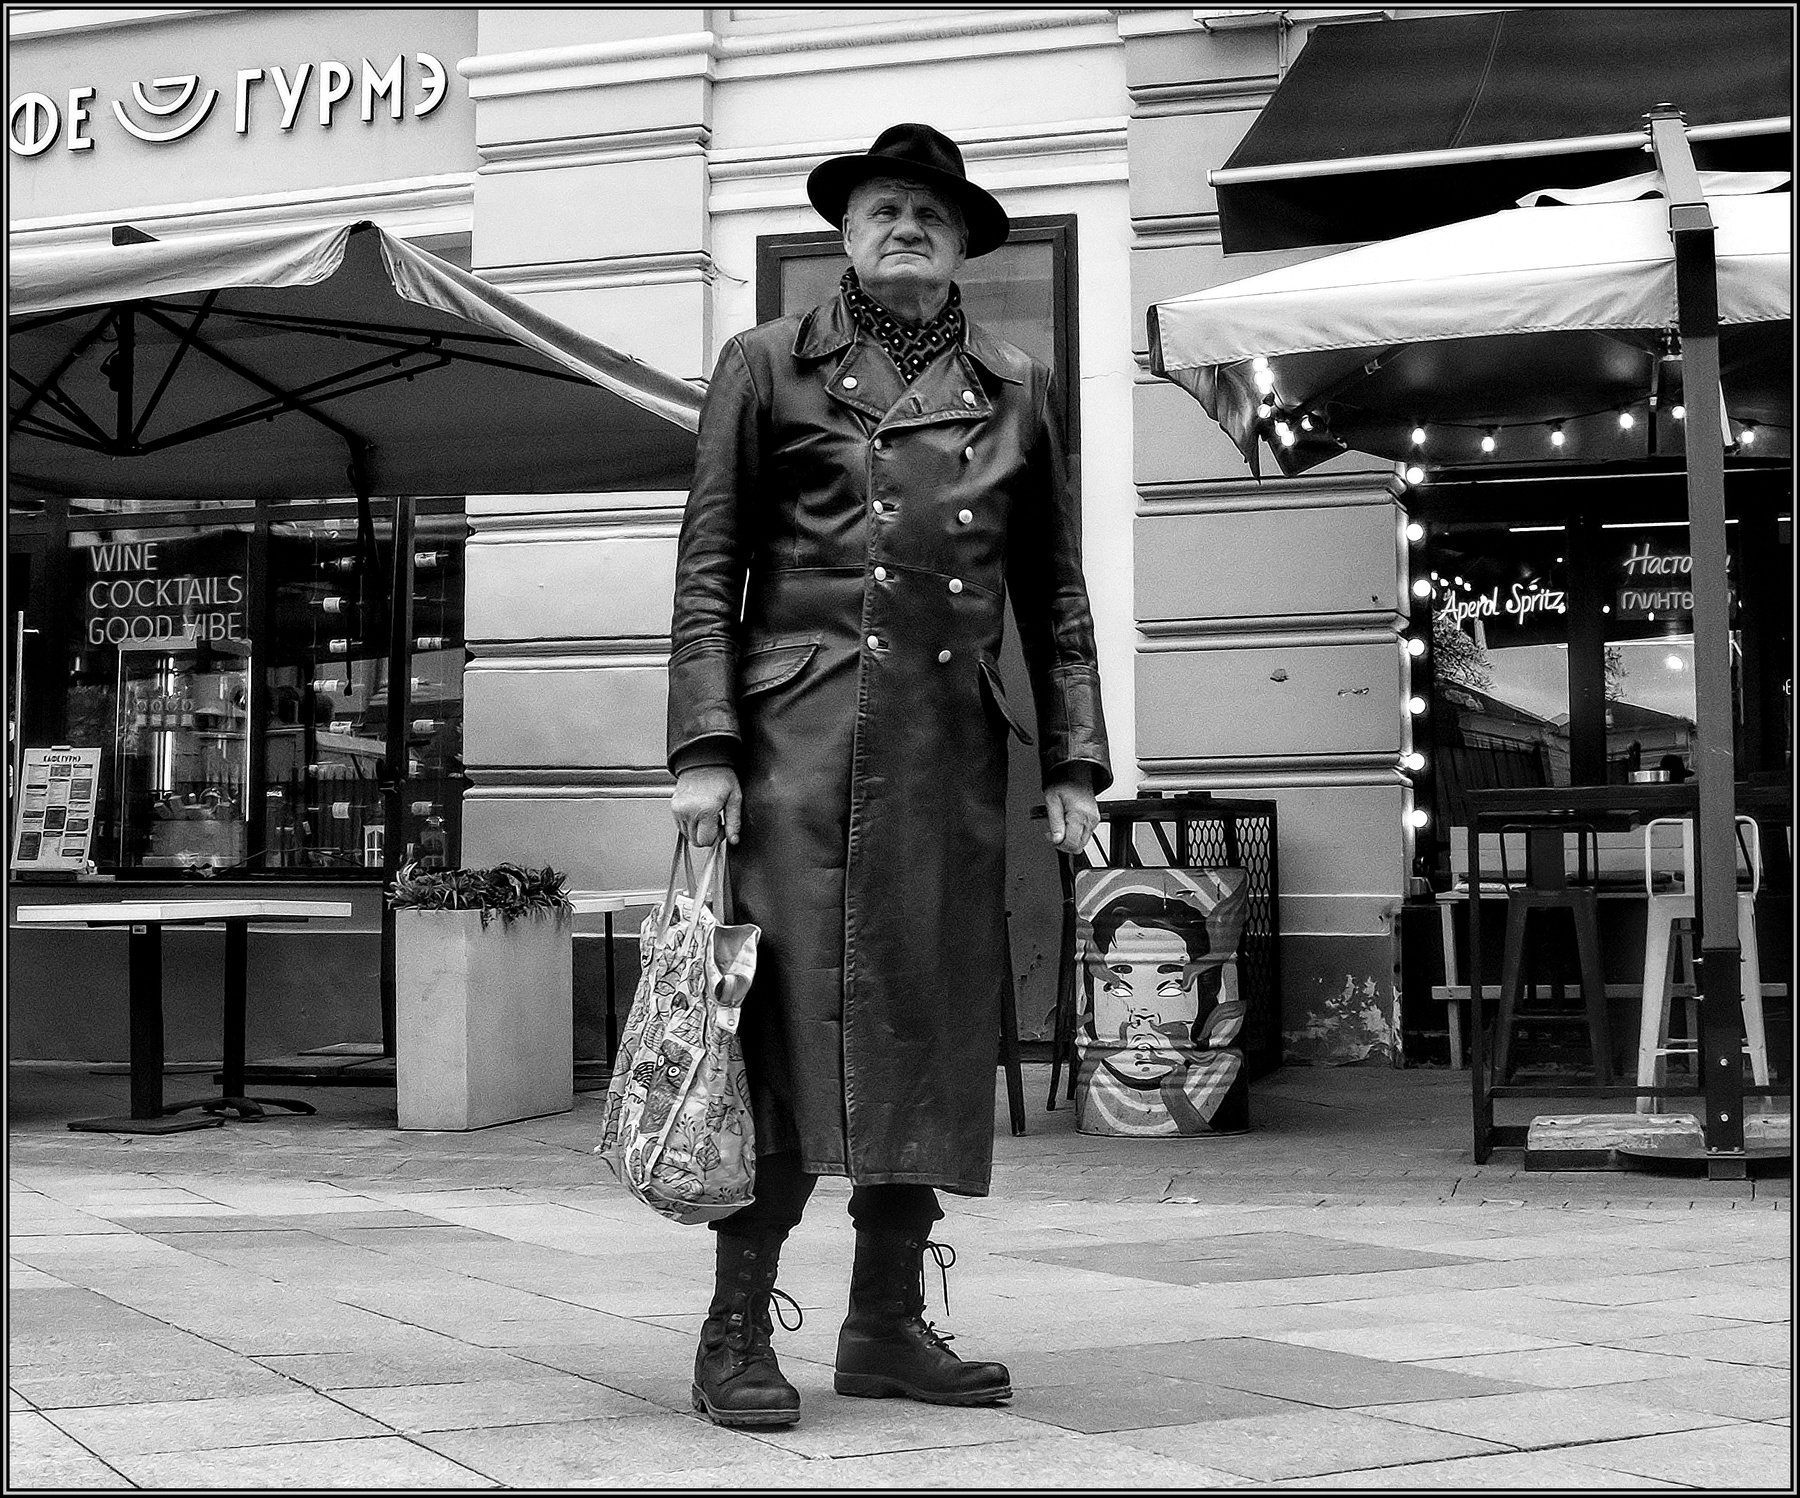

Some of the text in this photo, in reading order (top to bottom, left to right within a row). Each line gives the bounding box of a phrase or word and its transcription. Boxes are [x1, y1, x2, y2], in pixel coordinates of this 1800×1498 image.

[235, 52, 448, 134] ГУРМЭ
[90, 542, 158, 572] WINE
[1622, 543, 1731, 575] Насто
[89, 575, 243, 609] COCKTAILS
[1437, 582, 1565, 631] Aperol Spritz
[88, 612, 242, 645] GOOD VIBE
